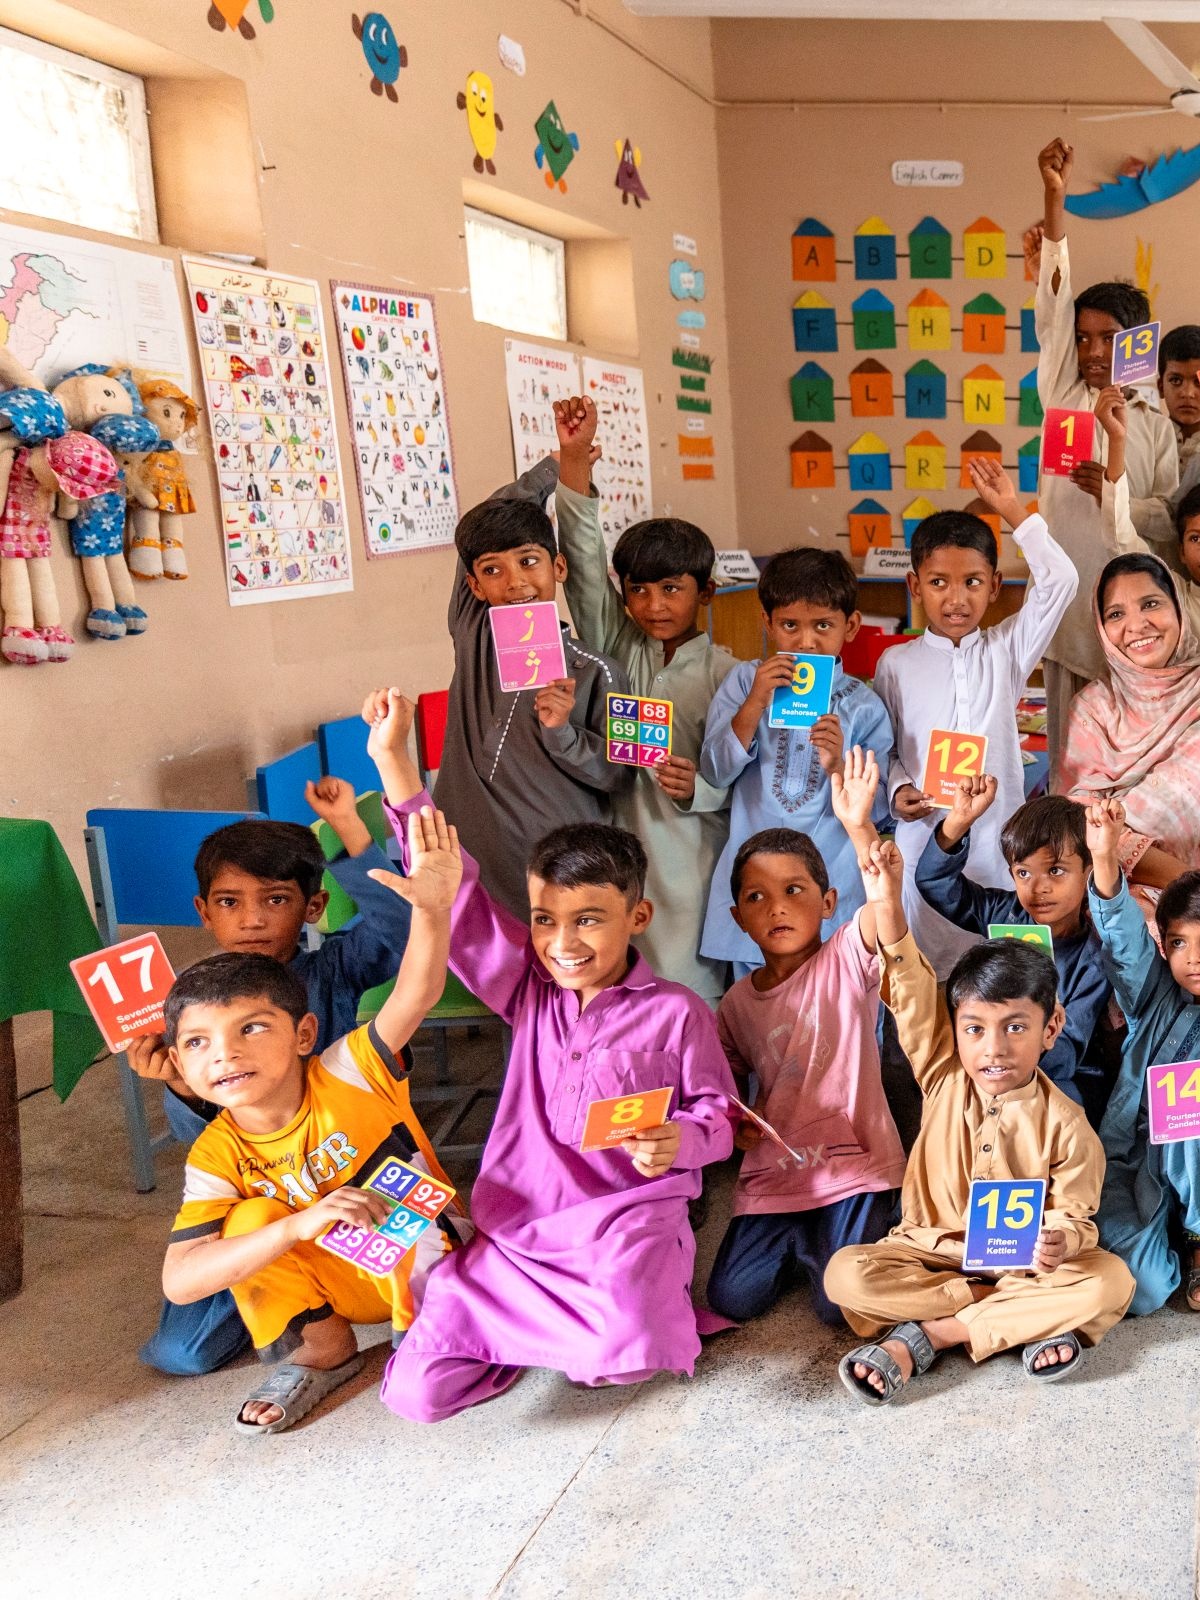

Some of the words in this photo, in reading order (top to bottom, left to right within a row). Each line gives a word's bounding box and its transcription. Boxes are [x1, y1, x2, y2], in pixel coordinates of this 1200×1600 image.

[895, 165, 927, 185] English
[804, 245, 820, 267] A
[867, 247, 881, 266] B
[923, 246, 937, 265] C
[977, 247, 993, 266] D
[351, 294, 420, 319] ALPHABET
[343, 322, 349, 333] A
[367, 325, 372, 336] B
[390, 327, 396, 338] C
[413, 330, 419, 340] D
[806, 320, 820, 338] F
[866, 320, 880, 339] G
[921, 319, 934, 336] H
[980, 324, 987, 342] I
[1119, 329, 1154, 360] 13
[347, 355, 352, 366] E
[395, 359, 401, 369] G
[417, 361, 423, 371] H
[518, 354, 543, 367] ACTION
[545, 359, 567, 371] WORDS
[602, 371, 627, 384] INSECTS
[400, 391, 405, 401] K
[420, 392, 425, 401] L
[806, 391, 820, 409] K
[865, 385, 878, 402] L
[917, 388, 932, 405] M
[976, 393, 991, 412] N
[356, 422, 364, 432] M
[381, 421, 388, 431] N
[403, 421, 410, 431] O
[425, 421, 430, 430] P
[1059, 415, 1075, 447] 1
[361, 454, 368, 464] Q
[384, 453, 390, 462] R
[407, 452, 412, 462] S
[1061, 453, 1074, 461] One
[1061, 459, 1073, 468] Boy
[806, 460, 818, 479] P
[861, 462, 875, 485] Q
[918, 459, 930, 476] R
[364, 485, 371, 495] U
[388, 484, 393, 494] V
[411, 482, 418, 491] W
[433, 481, 439, 490] X
[368, 517, 373, 526] Y
[393, 515, 398, 524] Z
[863, 525, 876, 544] V
[724, 565, 750, 574] Corner
[878, 559, 912, 569] Corner
[518, 610, 535, 643] ز
[524, 650, 541, 685] ژ
[791, 662, 816, 696] 9
[612, 699, 636, 714] 67
[643, 703, 667, 719] 68
[781, 708, 818, 717] Seahorses
[792, 701, 808, 709] Nine
[612, 721, 636, 736] 69
[643, 725, 666, 741] 70
[612, 742, 633, 758] 71
[642, 746, 665, 763] 72
[933, 738, 980, 777] 12
[88, 945, 155, 1005] 17
[610, 1098, 644, 1124] 8
[610, 1126, 636, 1136] Eight
[1167, 1119, 1200, 1130] Candels
[605, 1132, 632, 1141] Clock
[381, 1166, 414, 1192] 91
[375, 1183, 400, 1199] Ninety-One
[413, 1184, 447, 1211] 92
[977, 1188, 1034, 1231] 15
[390, 1211, 424, 1238] 94
[333, 1222, 369, 1248] 95
[987, 1238, 1017, 1246] Fifteen
[366, 1239, 401, 1266] 96
[986, 1246, 1017, 1255] Kettles
